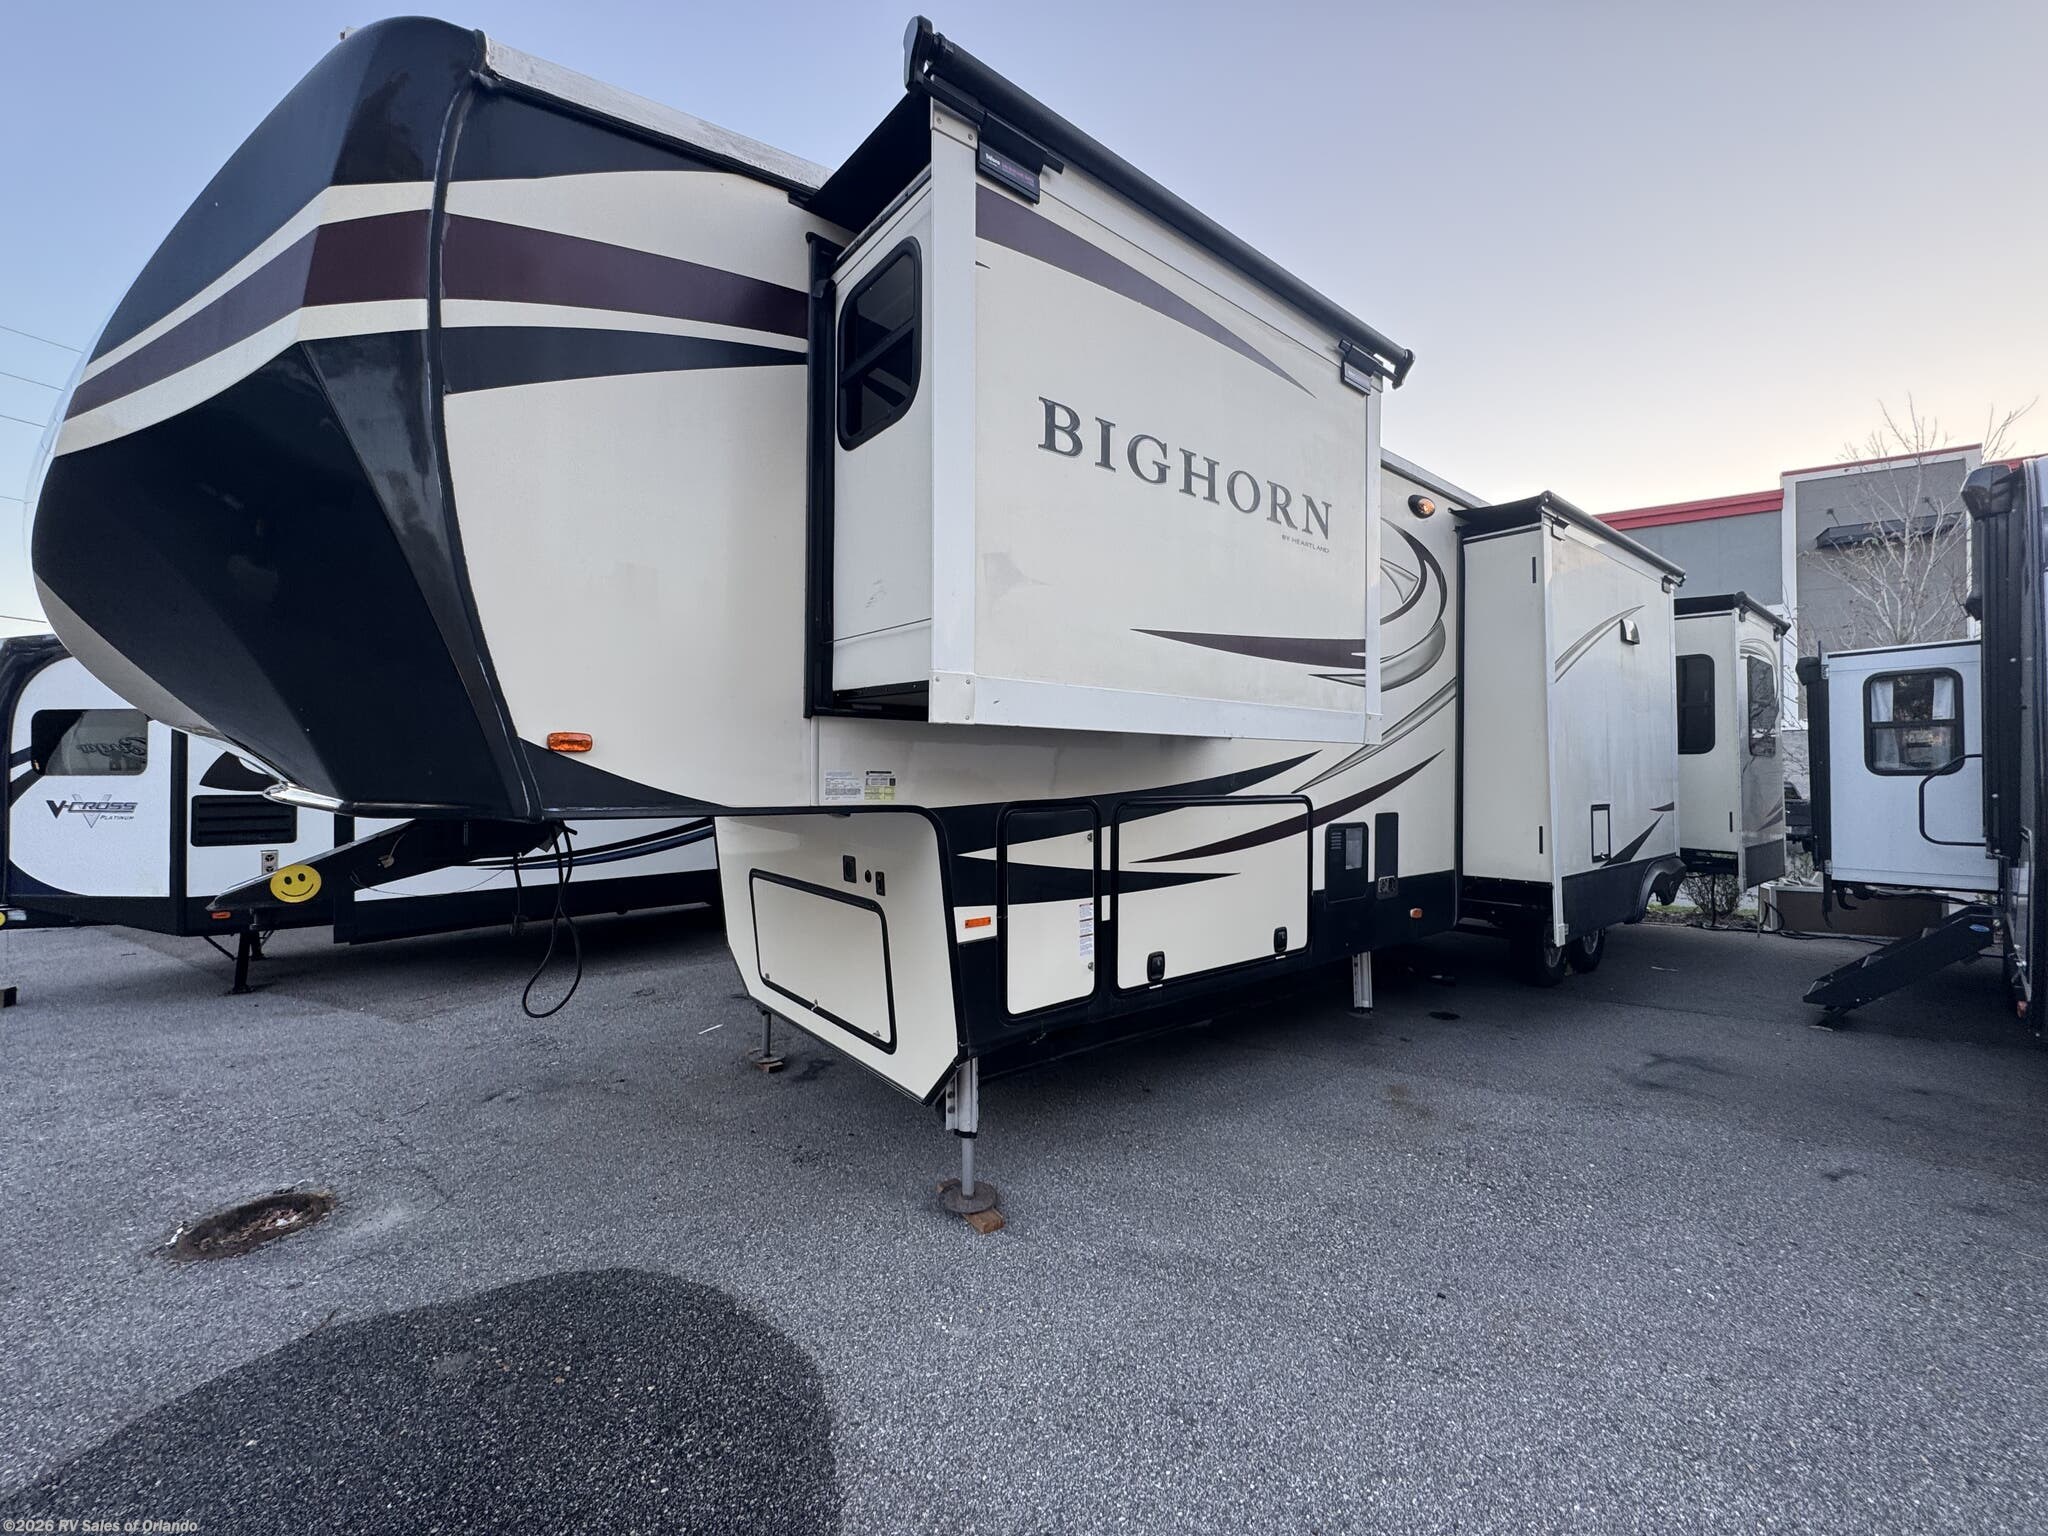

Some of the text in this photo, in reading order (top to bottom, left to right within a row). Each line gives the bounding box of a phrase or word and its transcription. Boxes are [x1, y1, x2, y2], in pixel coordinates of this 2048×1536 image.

[1037, 395, 1332, 540] BIGHORN
[1291, 537, 1330, 553] HEARTLAND
[46, 799, 138, 819] V-CROSS
